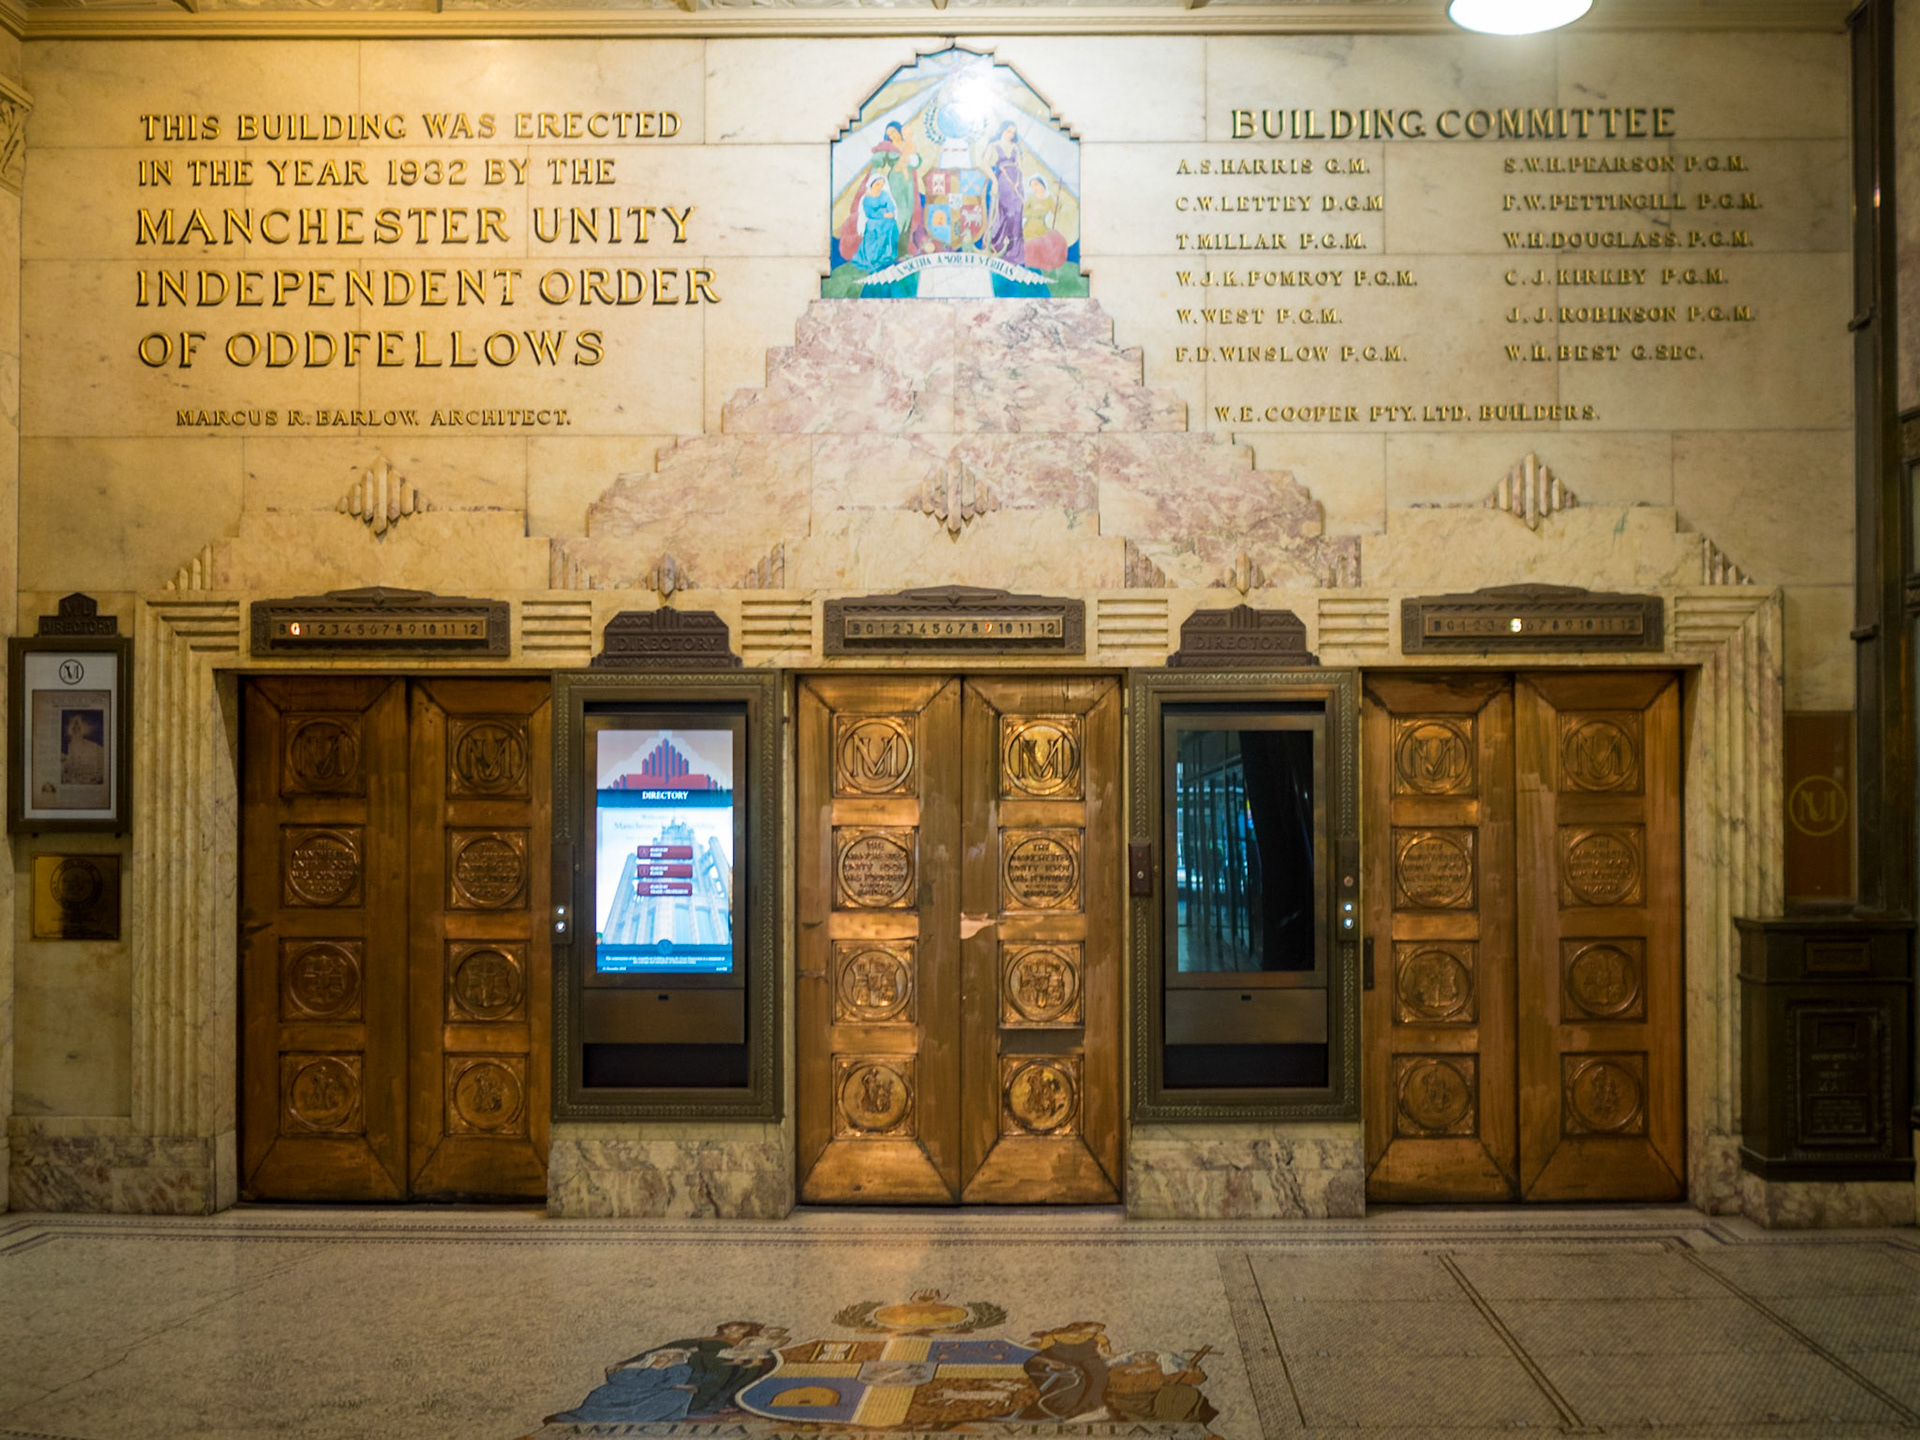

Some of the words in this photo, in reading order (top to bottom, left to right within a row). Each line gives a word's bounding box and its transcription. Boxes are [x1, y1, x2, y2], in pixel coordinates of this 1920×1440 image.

[140, 113, 221, 141] THIS
[237, 113, 406, 141] BUILDING
[422, 112, 497, 140] WAS
[515, 110, 682, 139] ERECTED
[1231, 108, 1425, 139] BUILDING
[1436, 107, 1676, 139] COMMITTEE
[138, 160, 173, 187] IN
[187, 159, 254, 187] THE
[266, 159, 369, 187] YEAR
[387, 159, 468, 187] 1932
[484, 157, 532, 186] BY
[547, 157, 617, 186] THE
[135, 206, 511, 246] MANCHESTER
[533, 205, 698, 245] UNITY
[135, 268, 522, 308] INDEPENDENT
[538, 266, 722, 307] ORDER
[138, 330, 206, 369] OF
[225, 329, 606, 368] ODDFELLOWS
[176, 409, 279, 427] MARCUS
[617, 637, 719, 651] DIRECTORY
[1194, 636, 1296, 650] DIRECTORY
[642, 790, 689, 801] DIRECTORY
